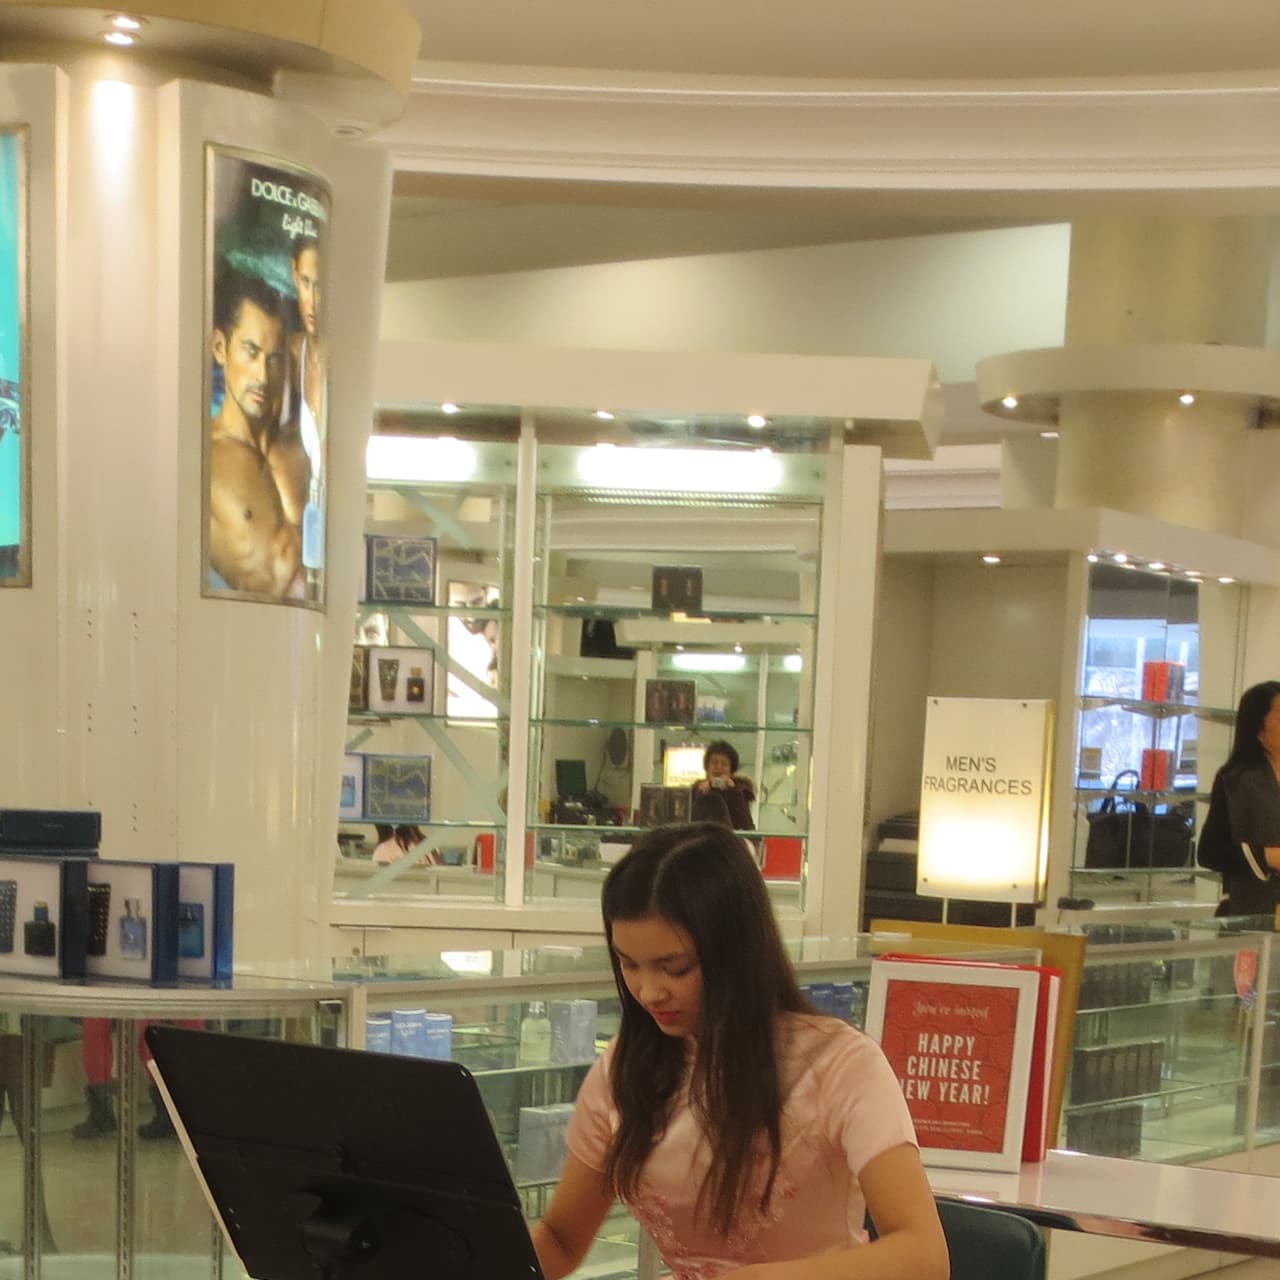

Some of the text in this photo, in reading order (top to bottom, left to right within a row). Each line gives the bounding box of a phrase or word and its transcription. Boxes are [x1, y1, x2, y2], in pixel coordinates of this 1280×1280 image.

[945, 755, 997, 773] MEN'S
[923, 776, 1032, 795] FRAGRANCES
[918, 1033, 976, 1057] HAPPY
[907, 1056, 982, 1080] CHINESE
[939, 1082, 991, 1105] YEAR!
